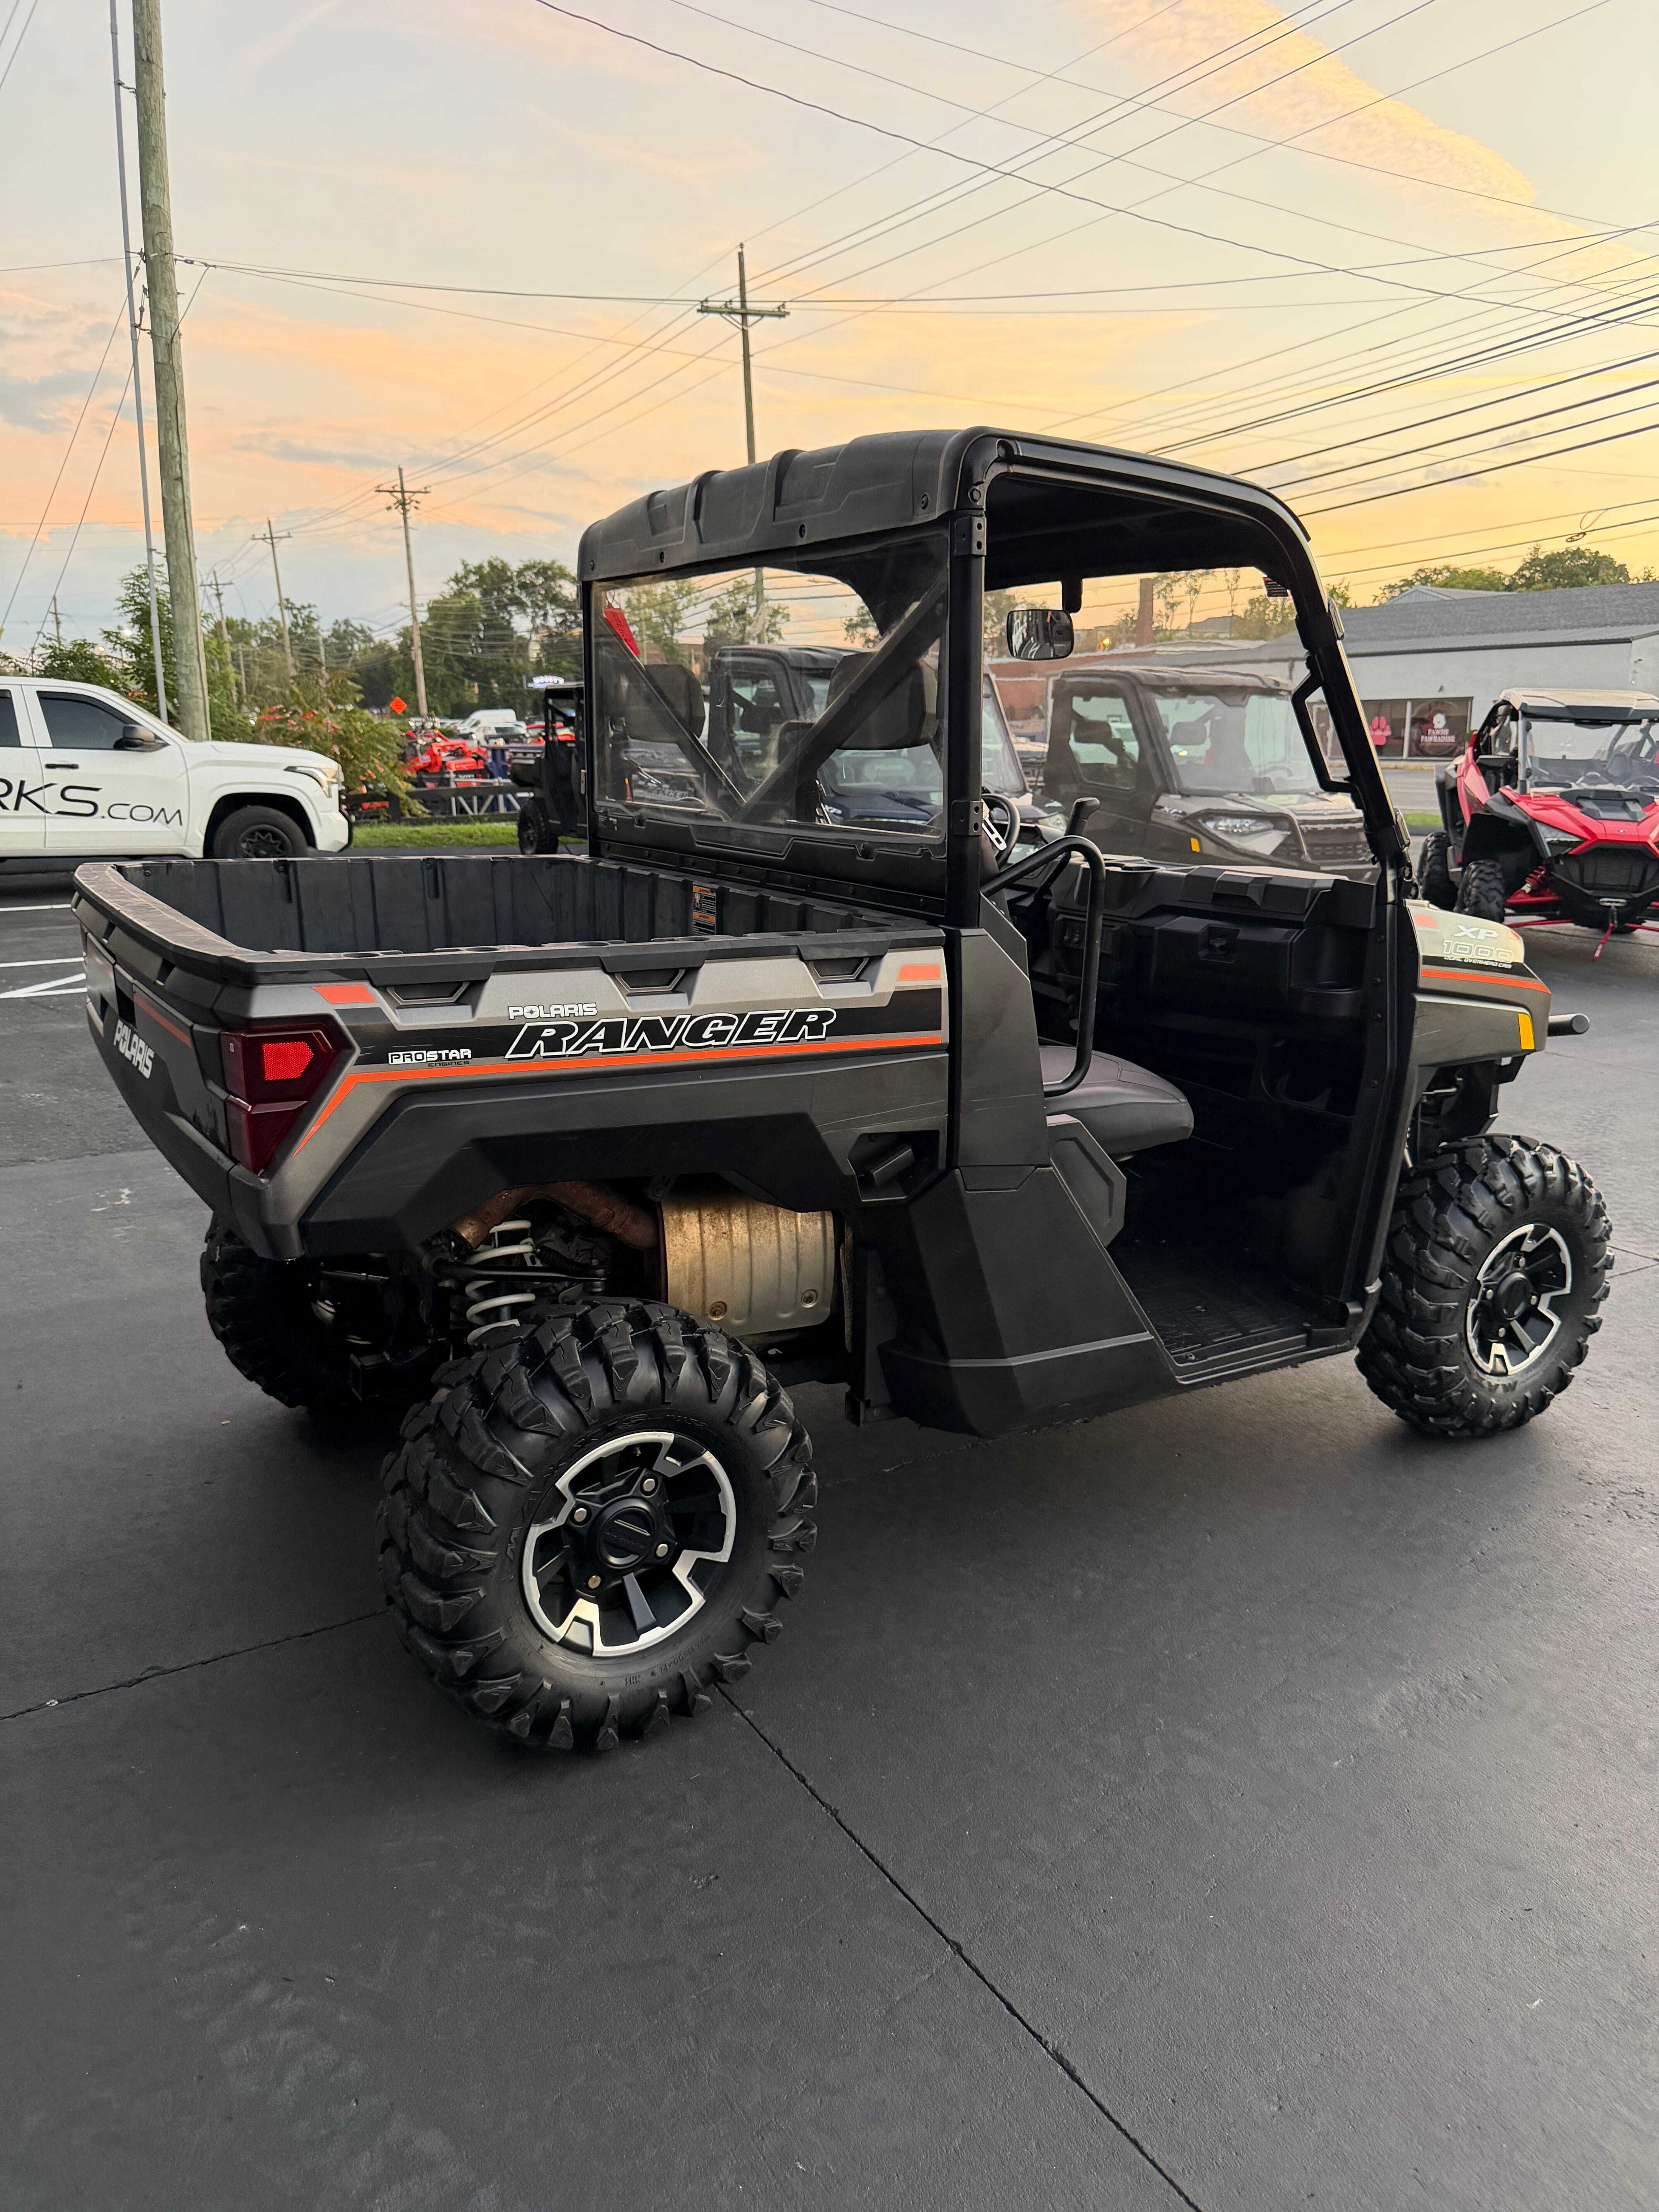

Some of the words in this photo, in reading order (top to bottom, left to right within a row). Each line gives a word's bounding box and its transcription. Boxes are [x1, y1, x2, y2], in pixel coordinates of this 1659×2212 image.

[1453, 924, 1499, 940] XP
[1443, 939, 1514, 963] 1000
[1463, 958, 1498, 967] OVERHEAD
[508, 1002, 597, 1020] POLARIS
[504, 1007, 837, 1060] RANGER
[113, 1019, 155, 1079] POLARIS
[388, 1049, 472, 1065] PROSTAR
